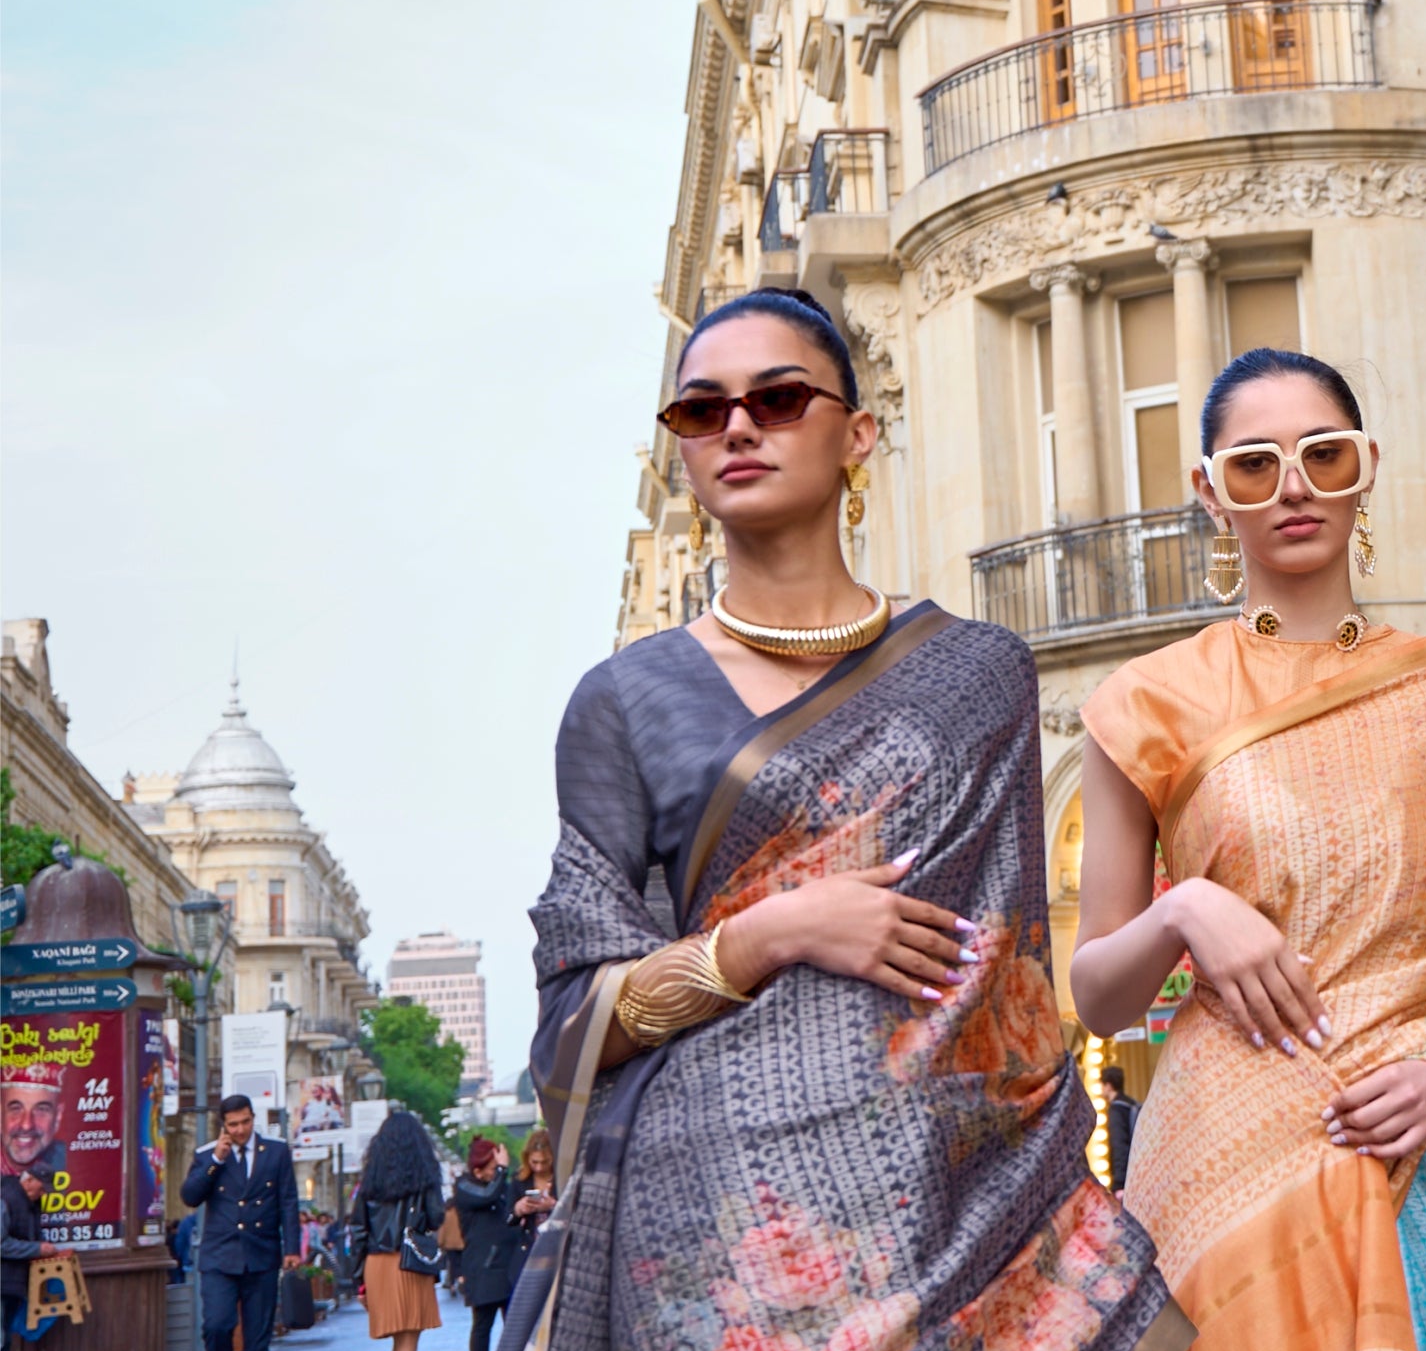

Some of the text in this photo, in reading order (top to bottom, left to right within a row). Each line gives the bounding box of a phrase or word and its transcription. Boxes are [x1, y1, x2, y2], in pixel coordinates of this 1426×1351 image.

[85, 1078, 108, 1096] 14
[78, 1096, 114, 1111] MAY
[72, 1226, 91, 1241] 35
[95, 1224, 113, 1239] 40
